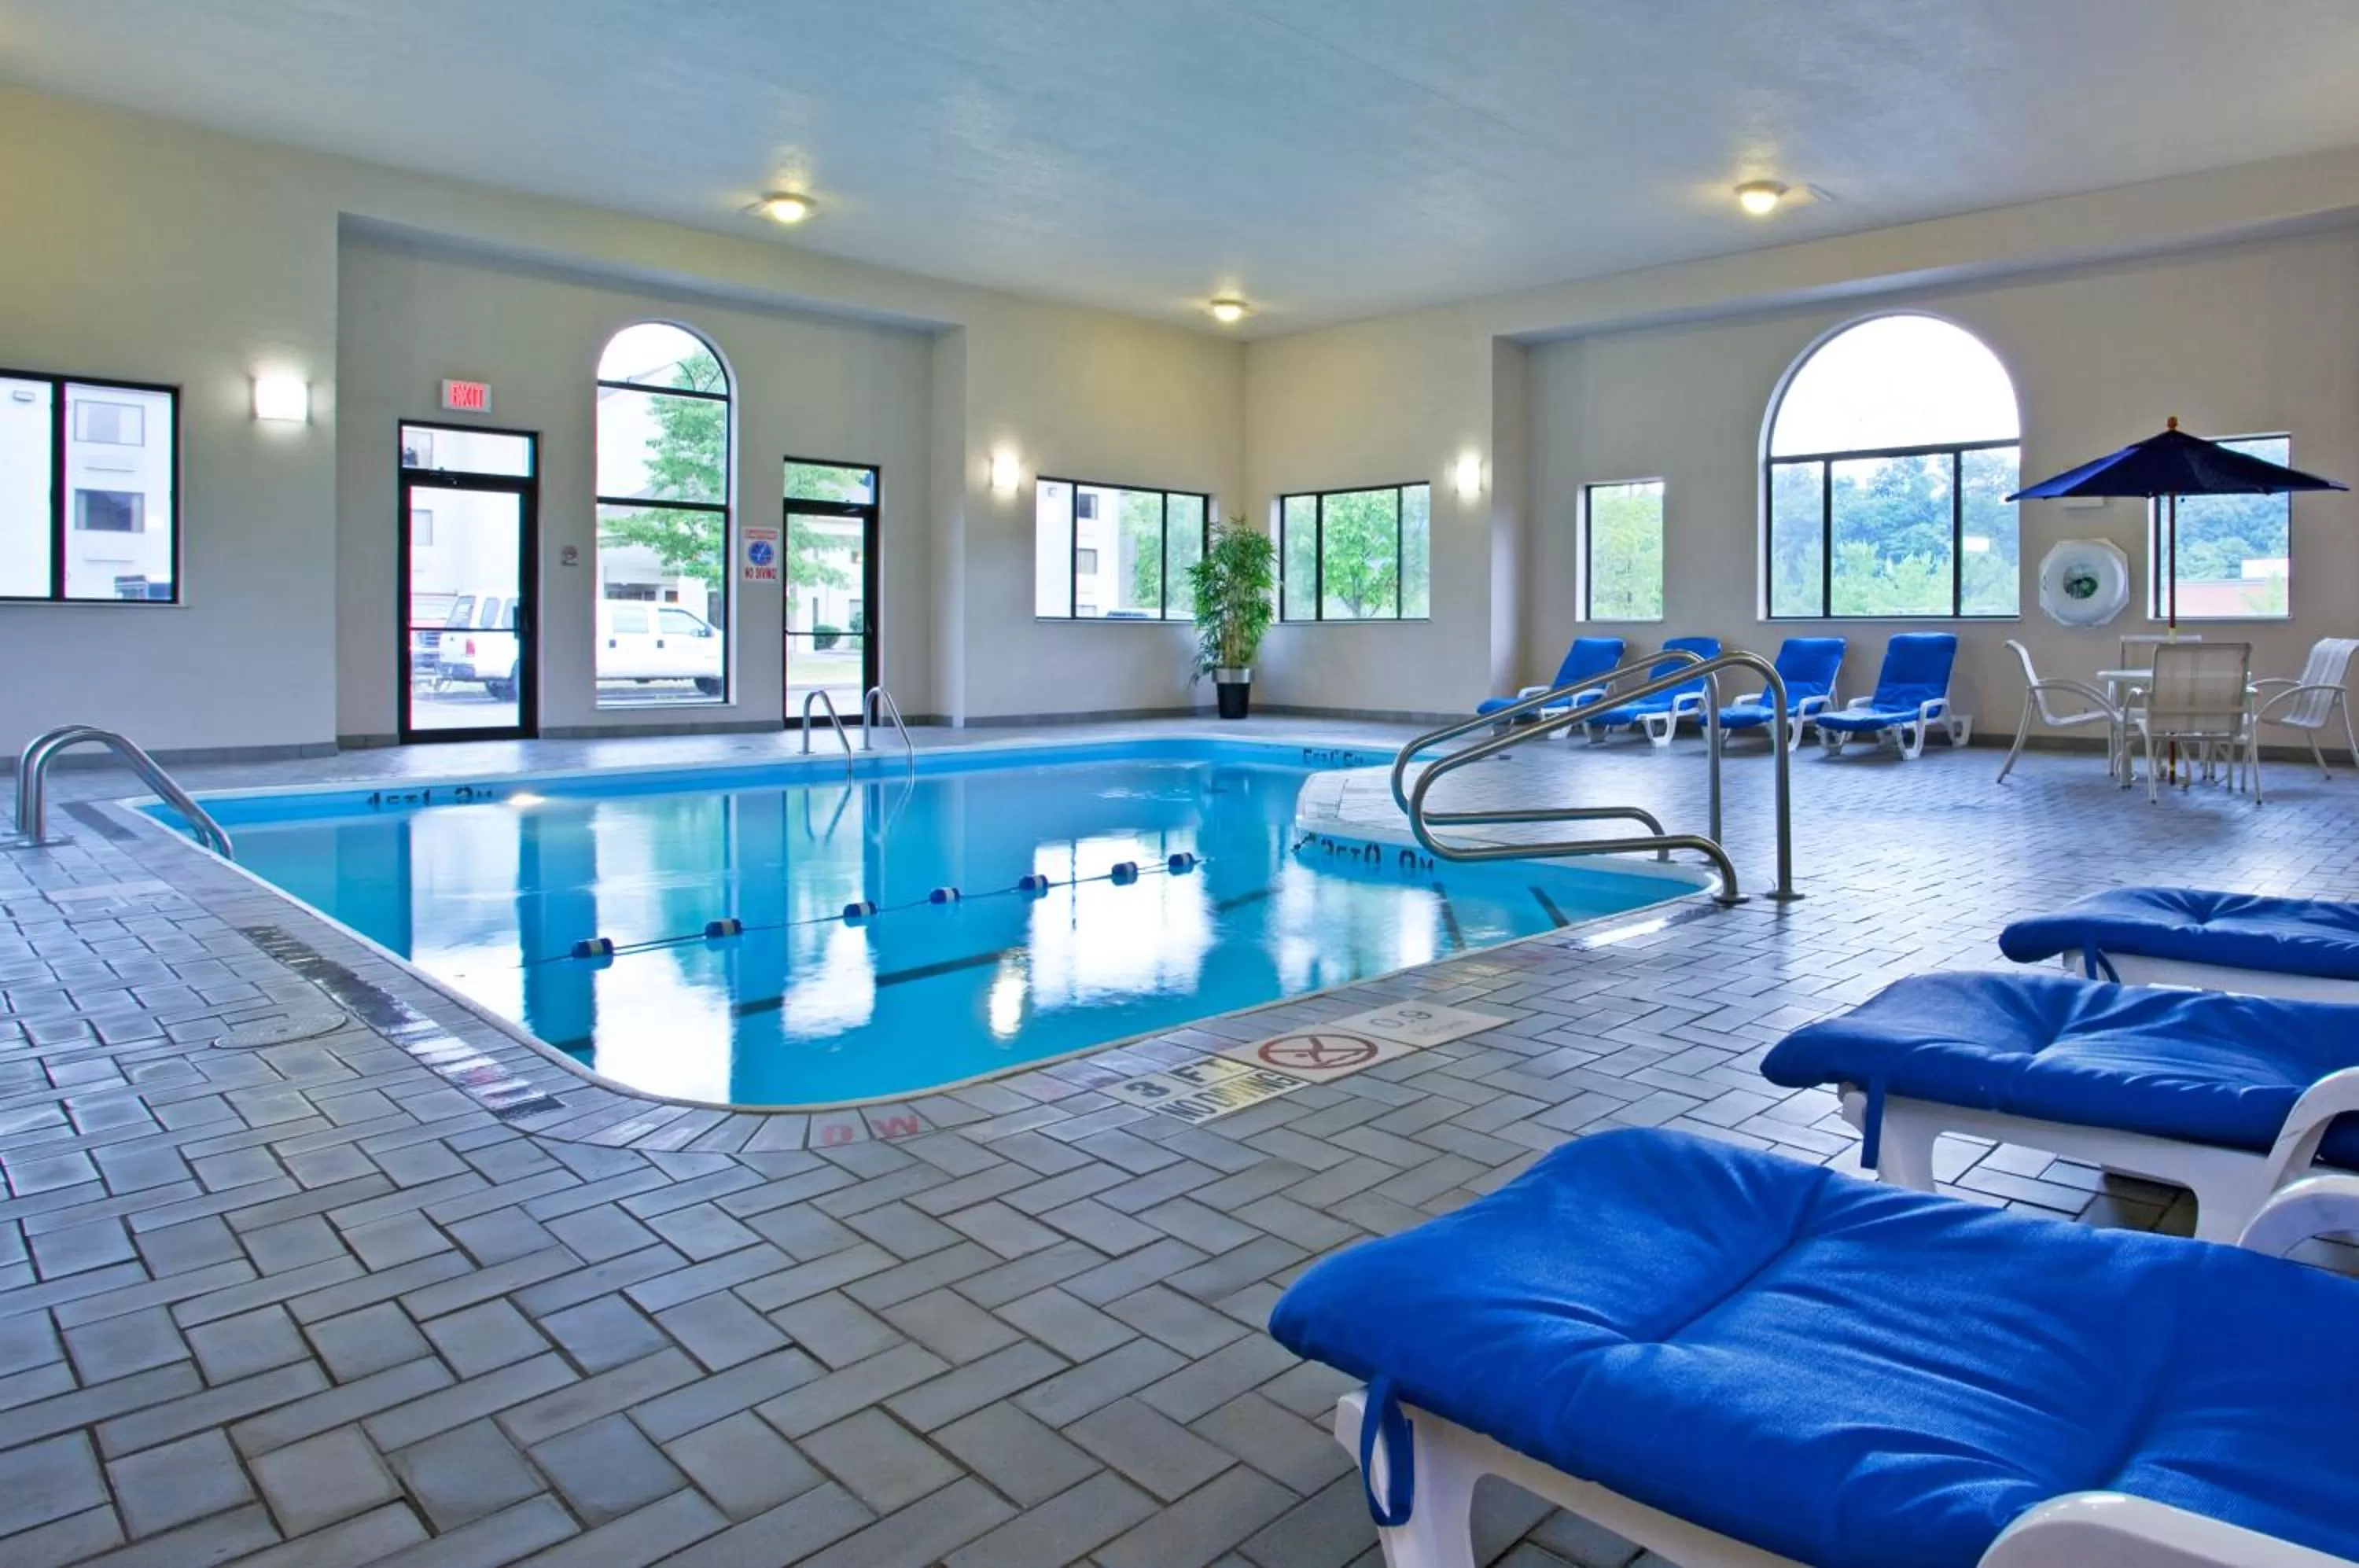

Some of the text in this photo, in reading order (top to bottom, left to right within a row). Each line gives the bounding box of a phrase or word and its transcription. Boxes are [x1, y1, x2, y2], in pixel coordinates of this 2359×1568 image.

[450, 382, 485, 408] EXIT
[745, 566, 777, 579] NO DIVING
[1124, 1080, 1171, 1098] 3
